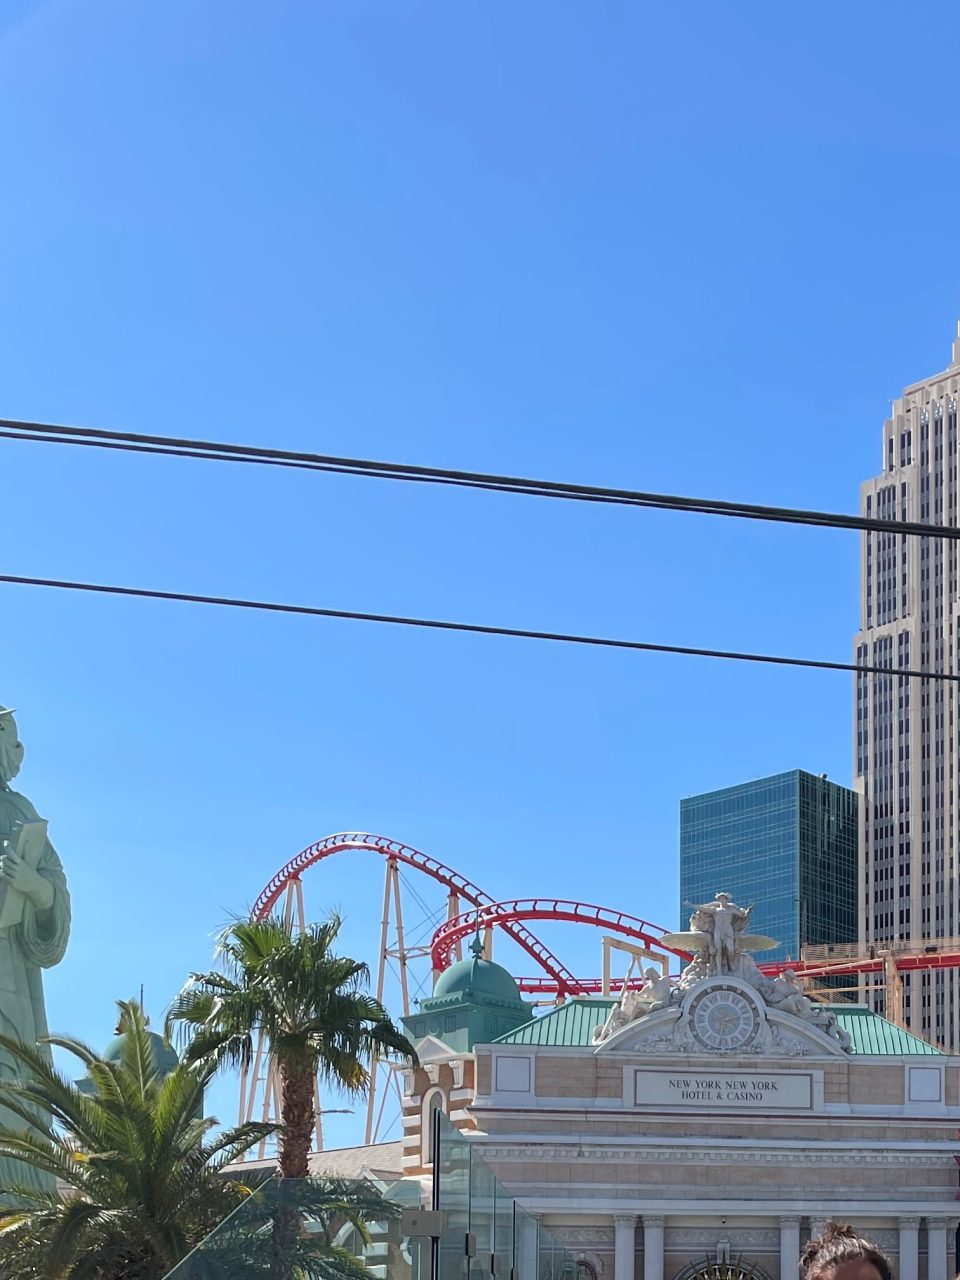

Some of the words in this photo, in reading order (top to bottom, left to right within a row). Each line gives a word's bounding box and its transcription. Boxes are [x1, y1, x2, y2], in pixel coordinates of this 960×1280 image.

[669, 1079, 691, 1089] NEW
[695, 1080, 722, 1090] YORK
[725, 1081, 748, 1090] NEW
[751, 1081, 778, 1091] YORK
[681, 1090, 713, 1100] HOTEL
[716, 1091, 723, 1100] &
[727, 1091, 763, 1101] CASINO
